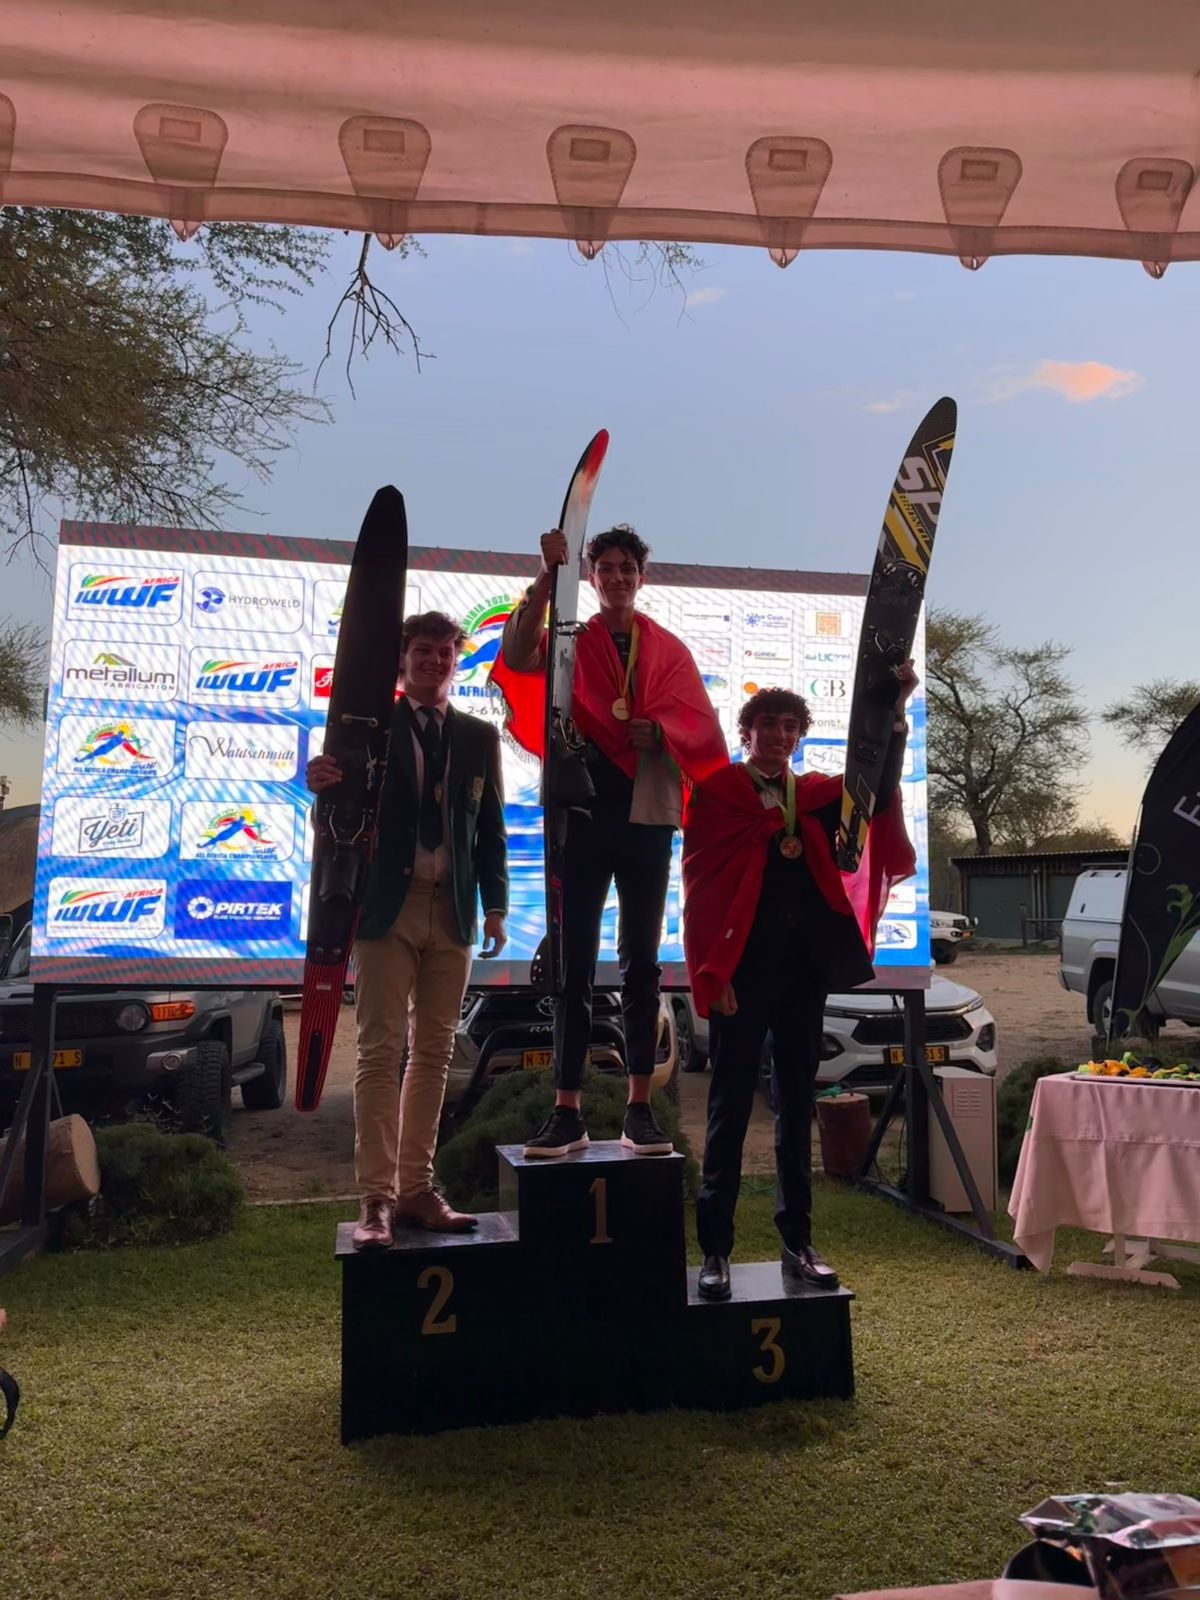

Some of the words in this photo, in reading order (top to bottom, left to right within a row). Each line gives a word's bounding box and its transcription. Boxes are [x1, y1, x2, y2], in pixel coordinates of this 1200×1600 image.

[143, 576, 180, 585] AFRICA
[228, 595, 301, 609] HYDROWELD
[262, 661, 299, 670] AFRICA
[66, 666, 175, 685] metallum
[104, 682, 175, 691] FABRICATION
[189, 735, 295, 760] Waldschmidt
[83, 818, 138, 848] Yeti
[124, 888, 164, 898] AFRICA
[214, 902, 284, 915] PIRTEK
[74, 1051, 80, 1064] S
[526, 1053, 533, 1066] N
[587, 1177, 613, 1245] 1
[416, 1265, 458, 1335] 2
[751, 1317, 785, 1384] 3
